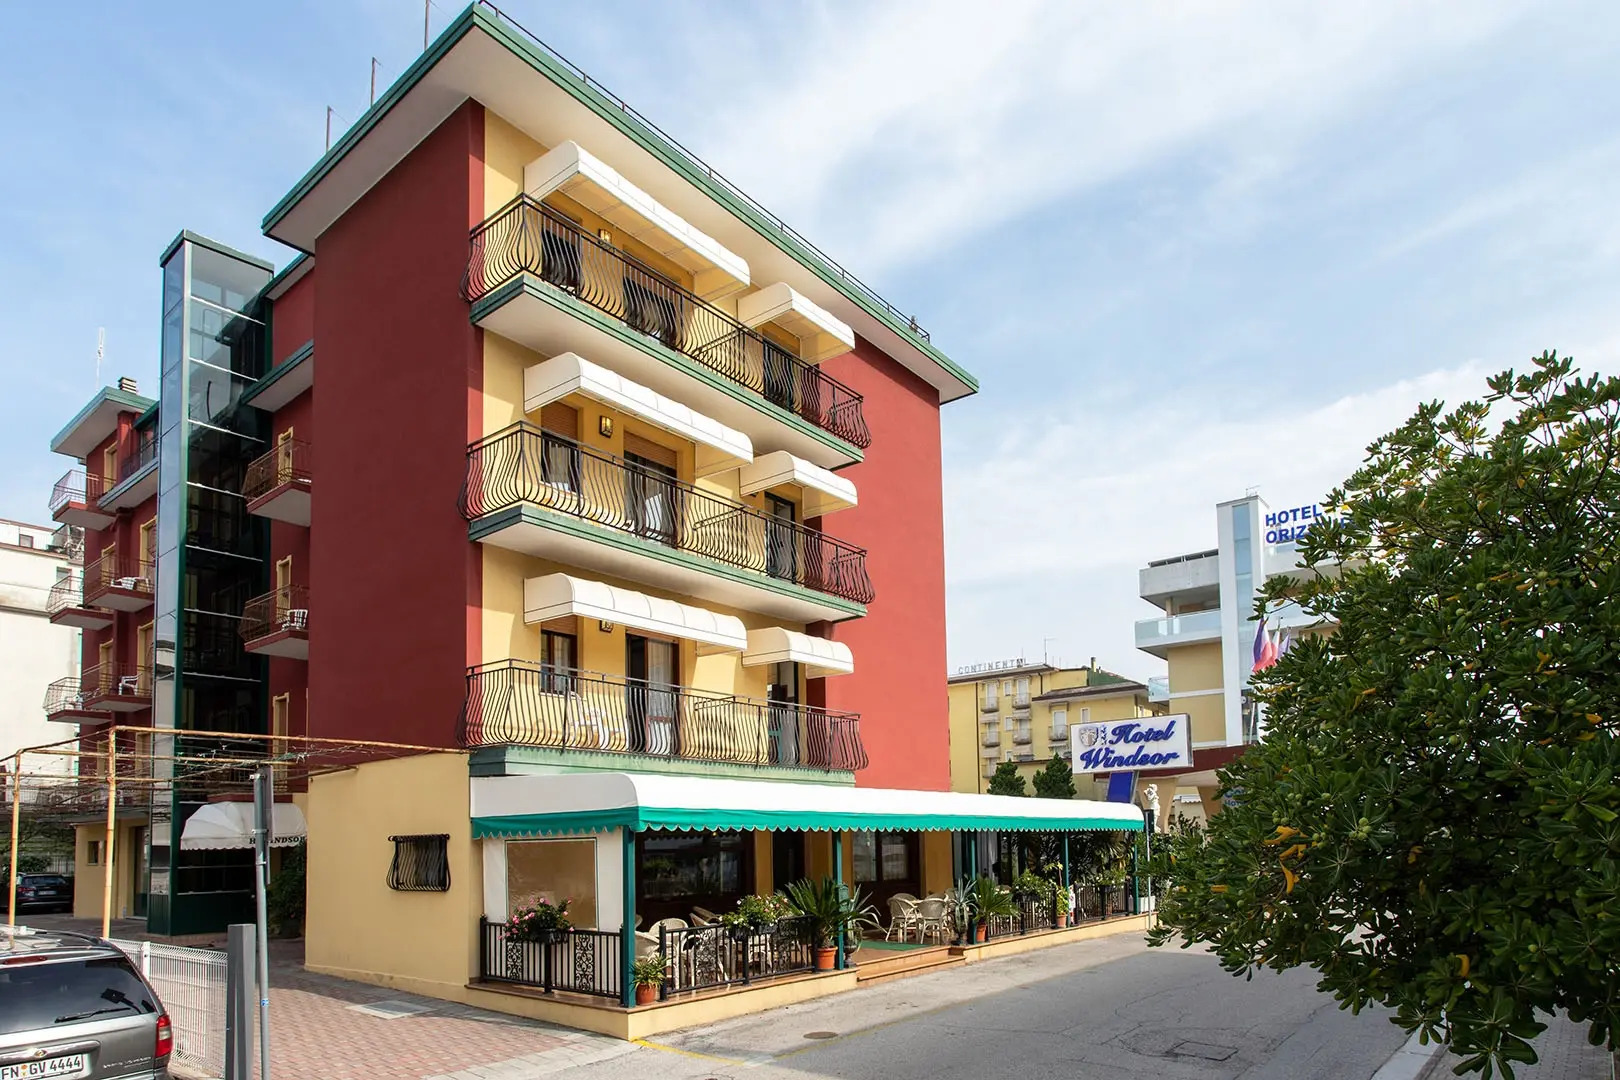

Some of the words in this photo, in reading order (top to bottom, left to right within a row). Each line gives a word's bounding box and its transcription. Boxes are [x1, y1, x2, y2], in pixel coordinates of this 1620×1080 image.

[1265, 504, 1322, 527] HOTEL
[1108, 720, 1177, 745] Hotel
[1079, 745, 1180, 770] Windsor
[1, 1066, 19, 1080] FN
[29, 1061, 46, 1075] GV
[50, 1056, 81, 1071] 4444
